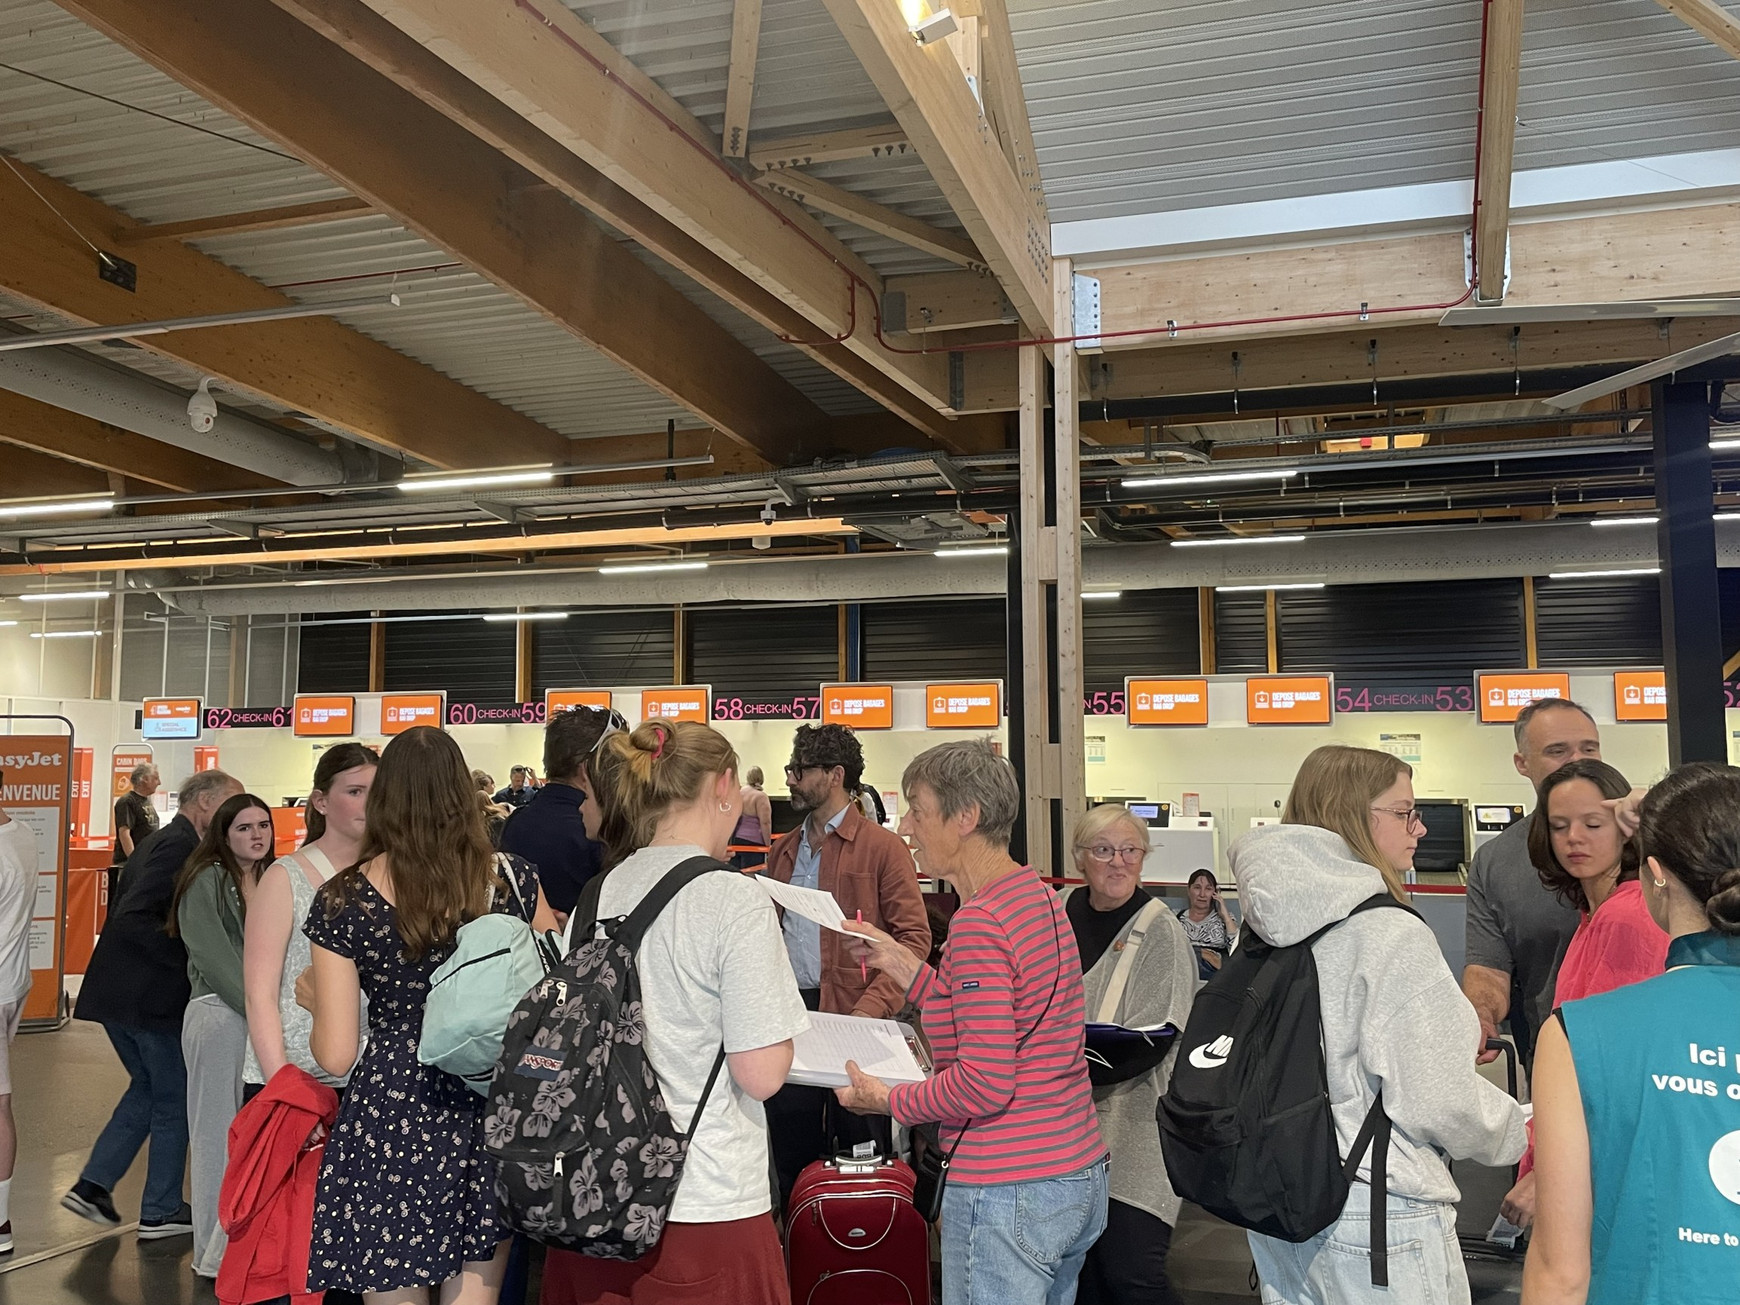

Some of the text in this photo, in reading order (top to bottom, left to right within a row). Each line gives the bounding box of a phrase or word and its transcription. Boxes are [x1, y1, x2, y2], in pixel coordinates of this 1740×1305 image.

[714, 697, 820, 720] 58 CHECK-IN 57
[1093, 691, 1125, 715] 55
[1336, 686, 1472, 712] 54 CHECK-IN 53
[207, 707, 294, 728] 62 CHECK-IN 61
[450, 702, 545, 724] 60 CHECK-IN 59
[1689, 1042, 1726, 1067] Ici
[1652, 1074, 1718, 1097] vous
[1678, 1227, 1739, 1247] Here to
